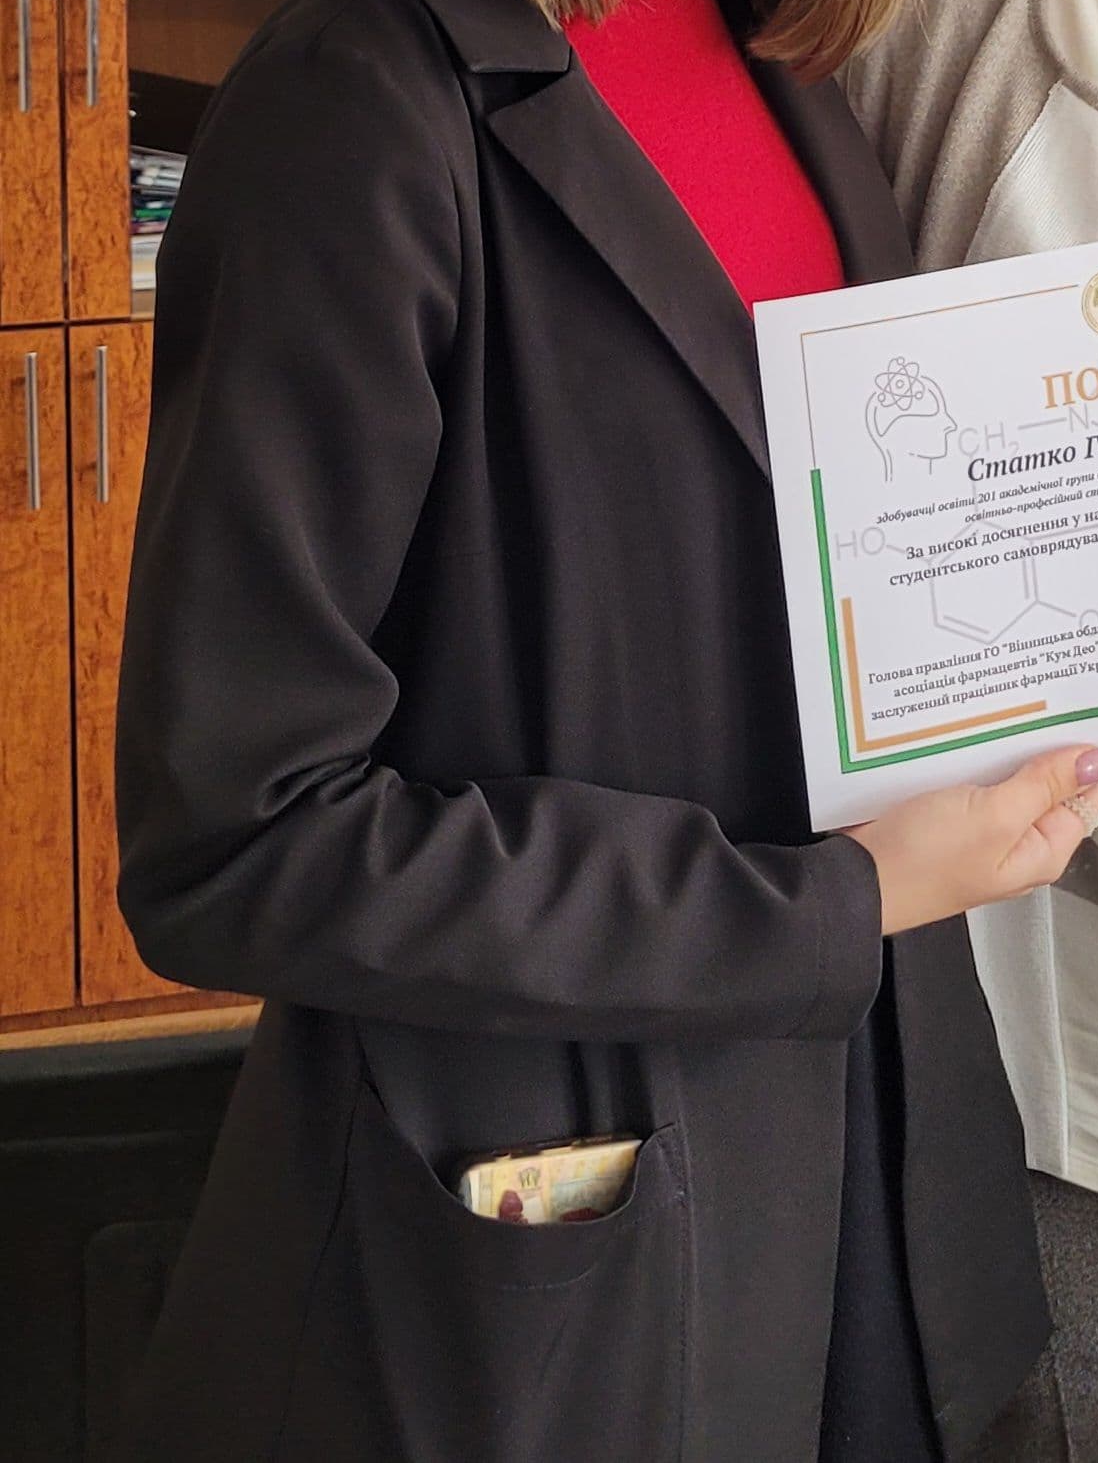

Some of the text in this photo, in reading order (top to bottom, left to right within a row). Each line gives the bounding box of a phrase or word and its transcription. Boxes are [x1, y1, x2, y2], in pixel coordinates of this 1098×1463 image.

[966, 445, 1077, 483] Статко
[936, 496, 977, 513] освіти
[975, 489, 997, 505] 201
[905, 545, 926, 561] За
[927, 531, 979, 557] високі
[980, 516, 1070, 547] досягнення
[1070, 513, 1082, 530] у
[888, 553, 1001, 587] студентського
[867, 667, 915, 686] Голова
[914, 651, 983, 677] правління
[982, 644, 1001, 660] ГО
[892, 673, 957, 699] асоціація
[956, 654, 1039, 687] фармацевтів
